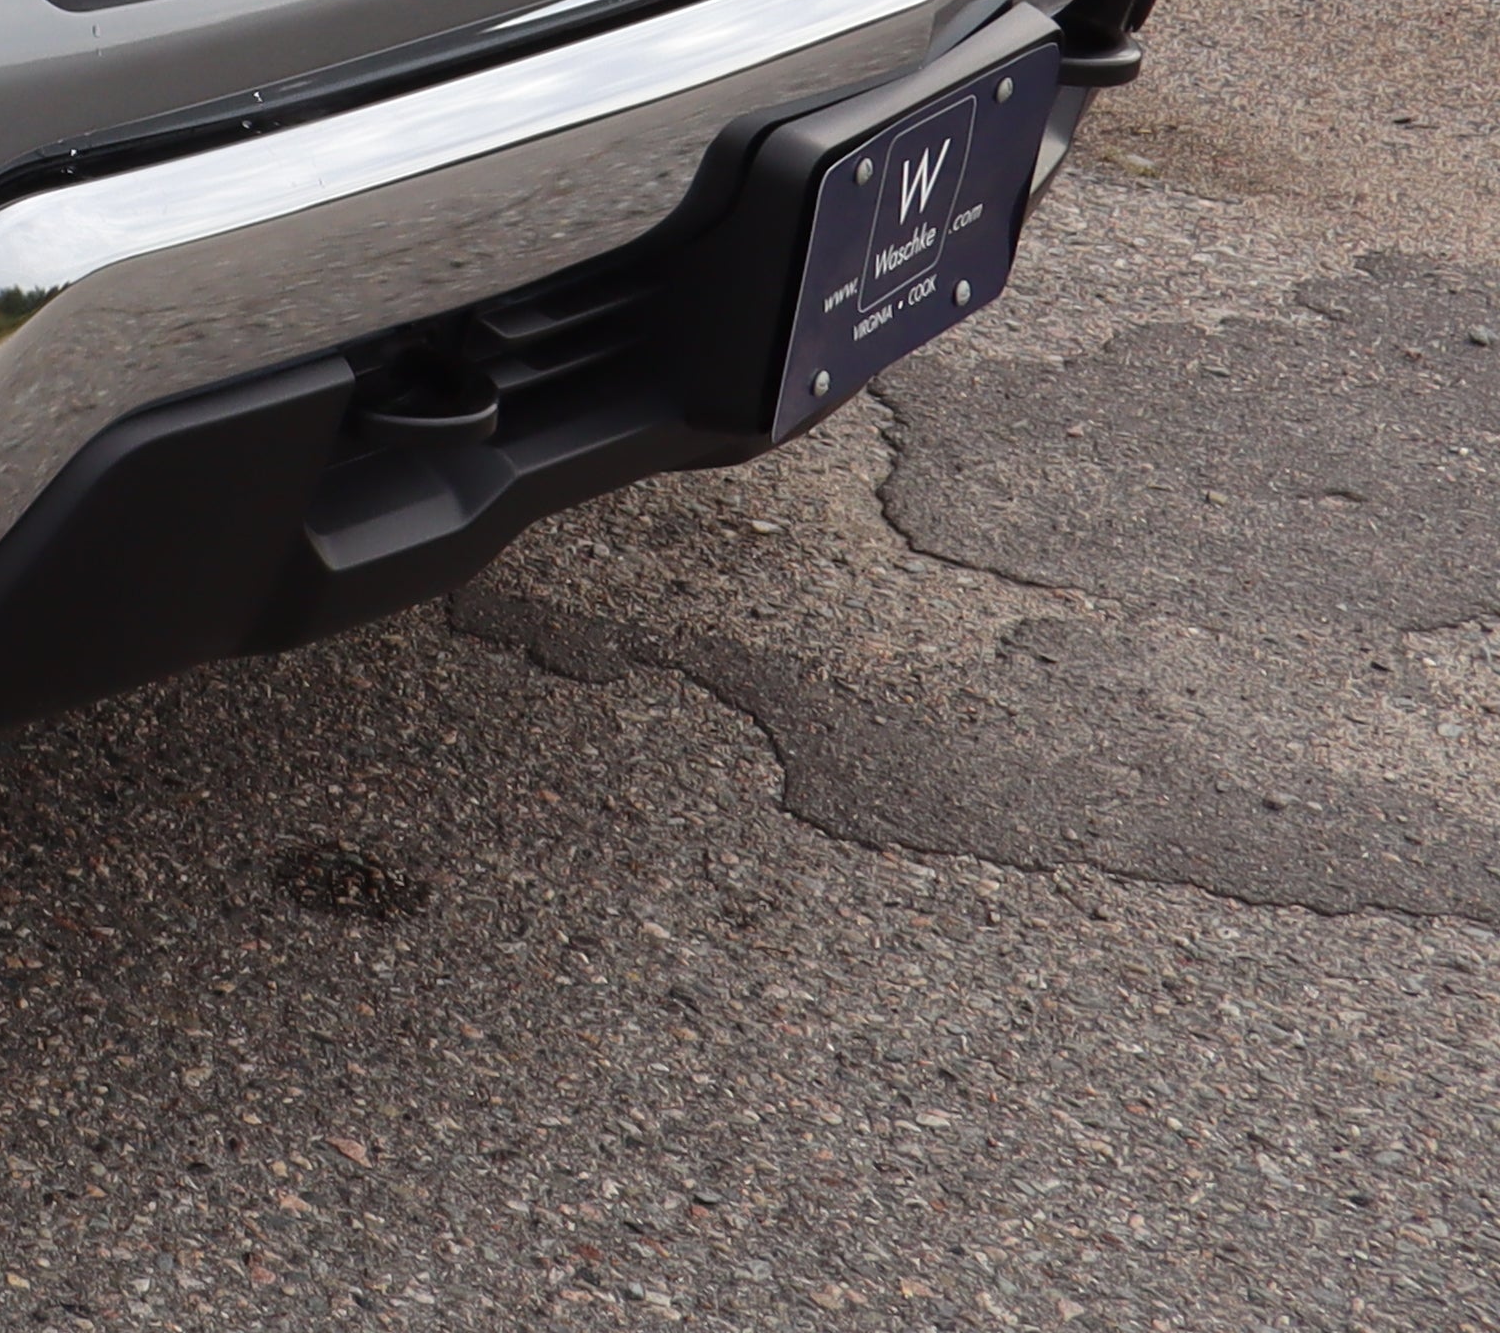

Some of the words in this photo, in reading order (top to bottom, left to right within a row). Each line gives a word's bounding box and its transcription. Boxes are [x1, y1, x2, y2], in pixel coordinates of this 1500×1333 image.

[900, 137, 951, 225] W
[874, 221, 937, 280] Waschke
[948, 203, 983, 235] .com
[852, 303, 894, 342] VIRGINIA
[907, 273, 938, 306] COOK
